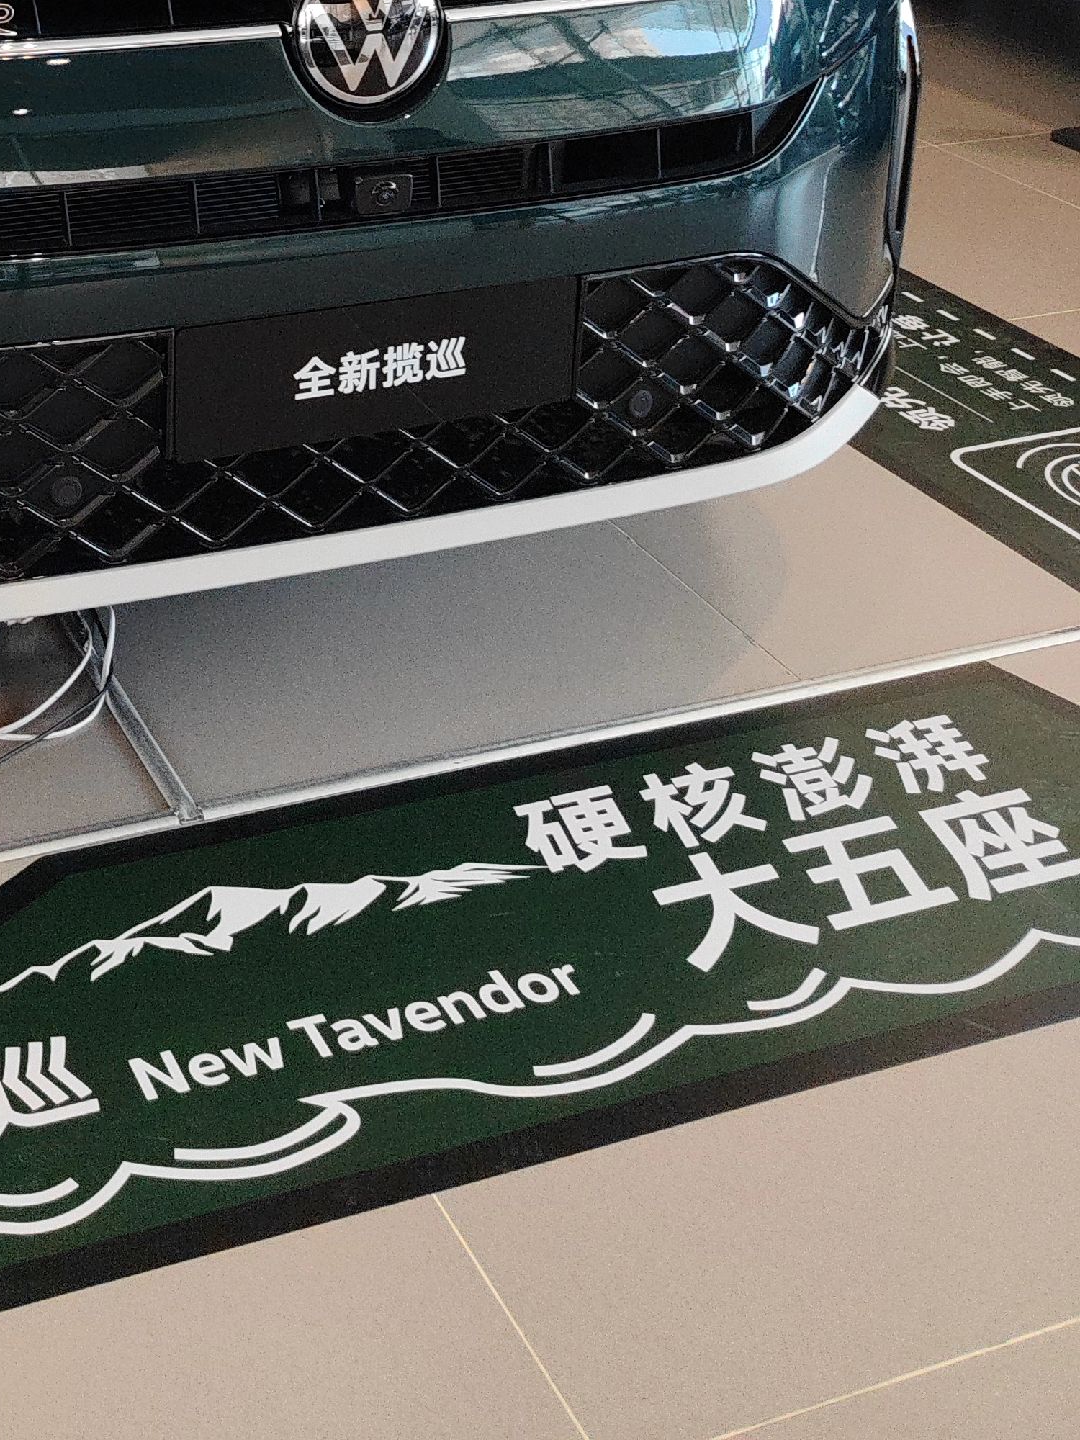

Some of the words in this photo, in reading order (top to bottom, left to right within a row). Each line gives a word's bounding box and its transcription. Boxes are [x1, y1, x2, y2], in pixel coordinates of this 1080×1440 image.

[293, 336, 467, 401] 全新揽巡
[514, 714, 990, 873] 硬核澎湃
[652, 788, 1080, 972] 大五座
[128, 1036, 284, 1101] New
[286, 964, 582, 1058] Tavendor
